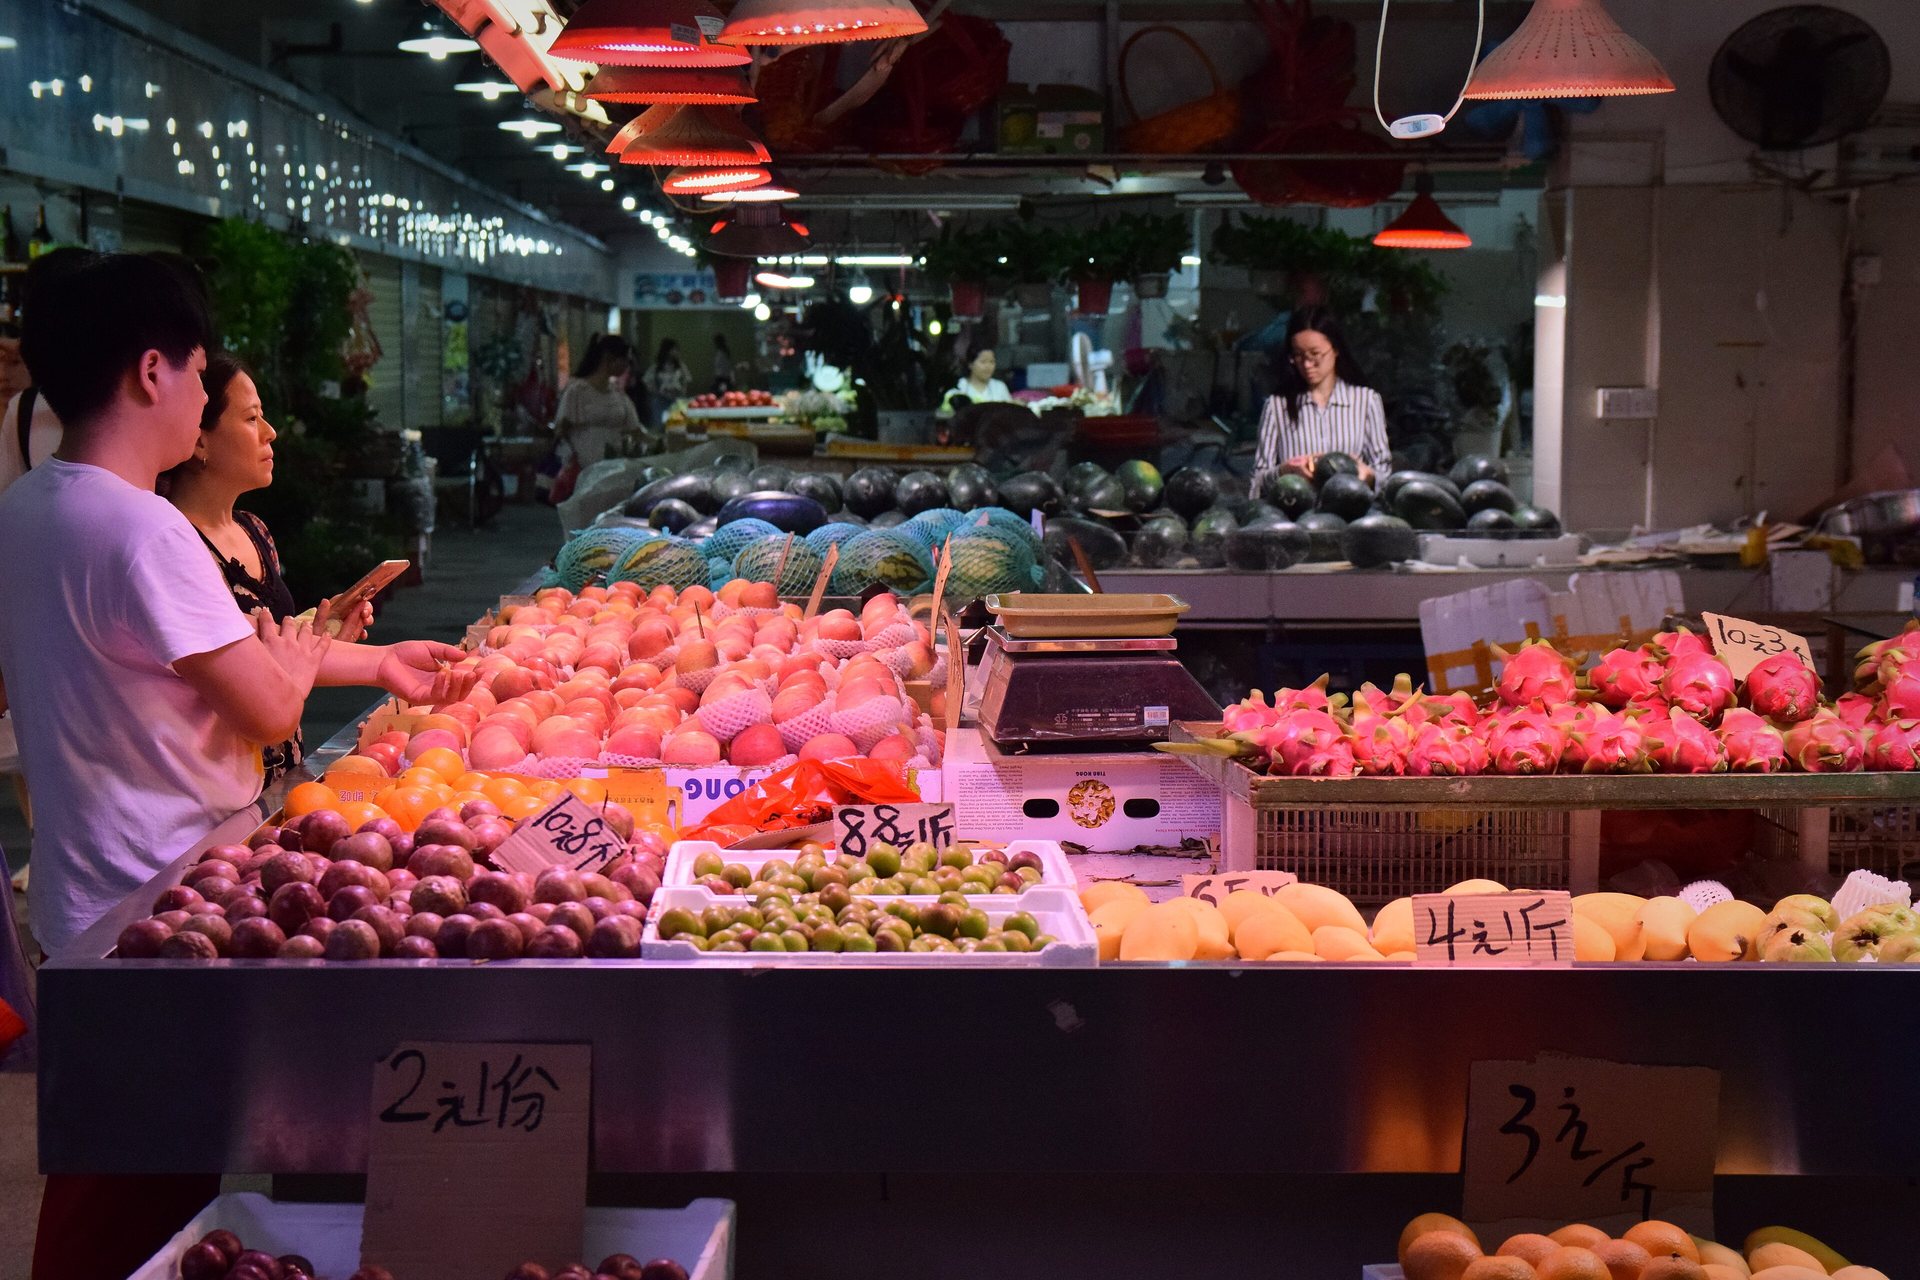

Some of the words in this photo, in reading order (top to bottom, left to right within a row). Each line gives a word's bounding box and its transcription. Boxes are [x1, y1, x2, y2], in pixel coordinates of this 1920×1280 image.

[684, 778, 763, 801] ONG
[1427, 899, 1566, 961] 4元1斤
[379, 1050, 560, 1133] 2元1份
[1499, 1084, 1657, 1221] 3元/斤
